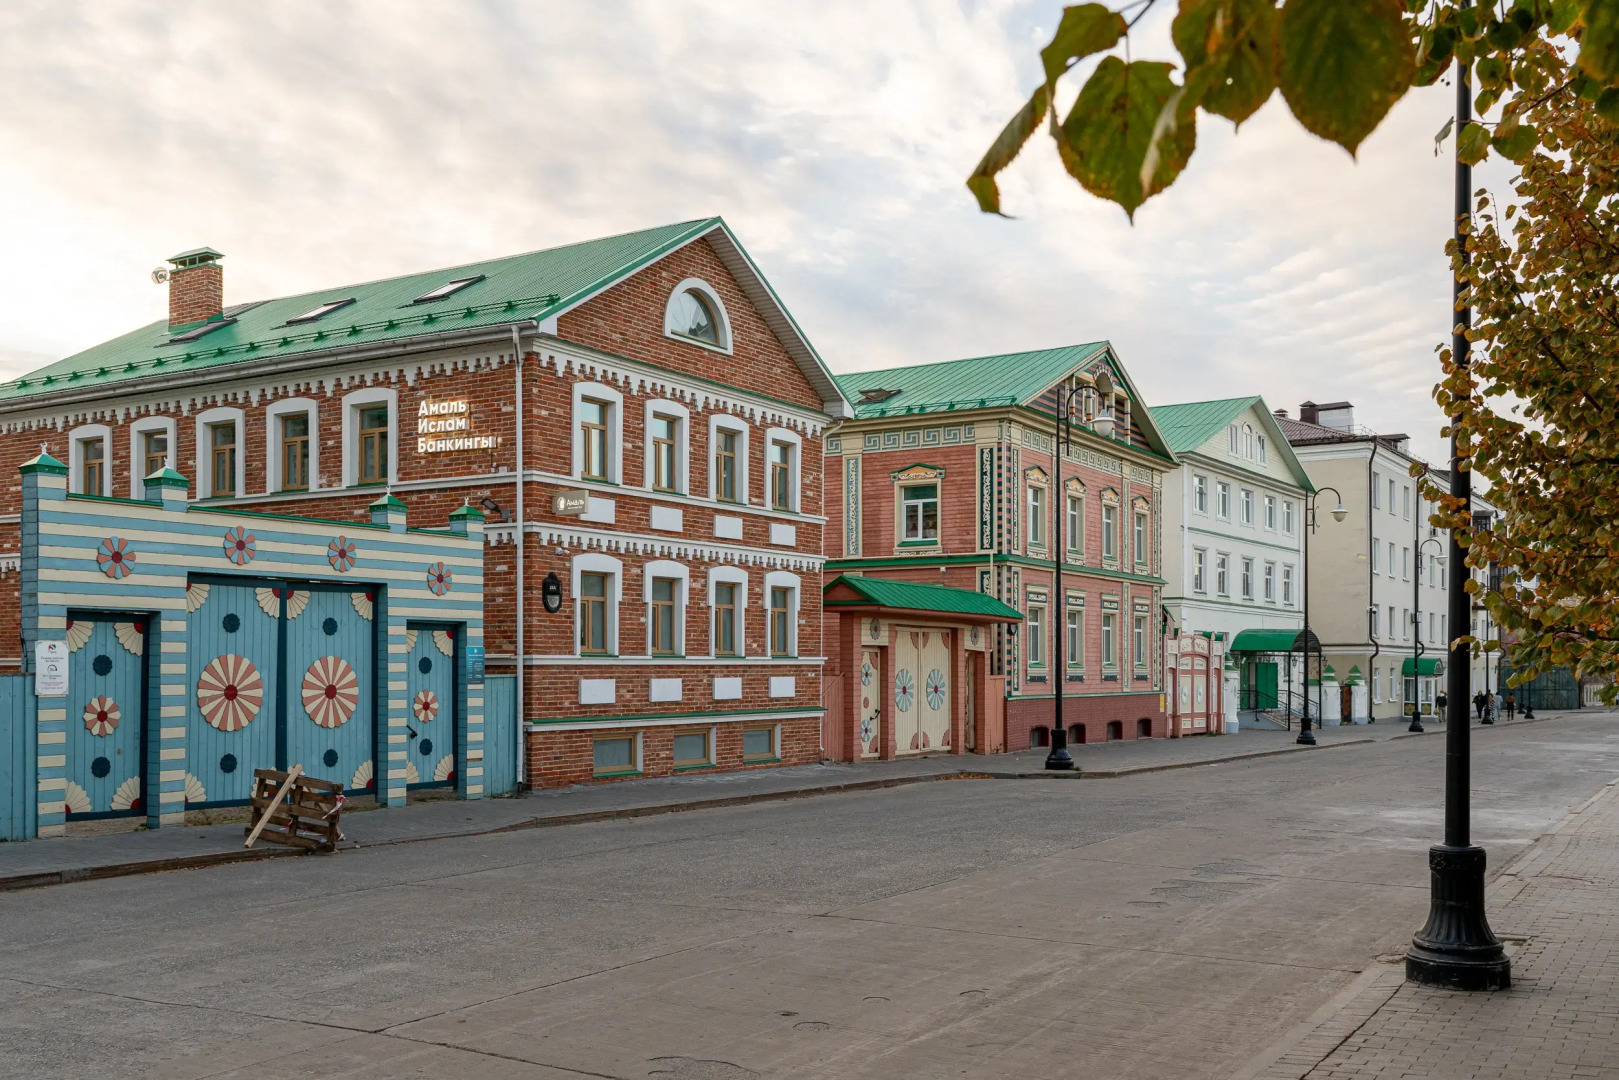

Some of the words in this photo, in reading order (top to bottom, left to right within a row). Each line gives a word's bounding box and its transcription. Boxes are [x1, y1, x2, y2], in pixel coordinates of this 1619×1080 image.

[418, 401, 466, 416] Амаль
[418, 418, 466, 433] Ислам
[418, 436, 494, 453] Банкингы
